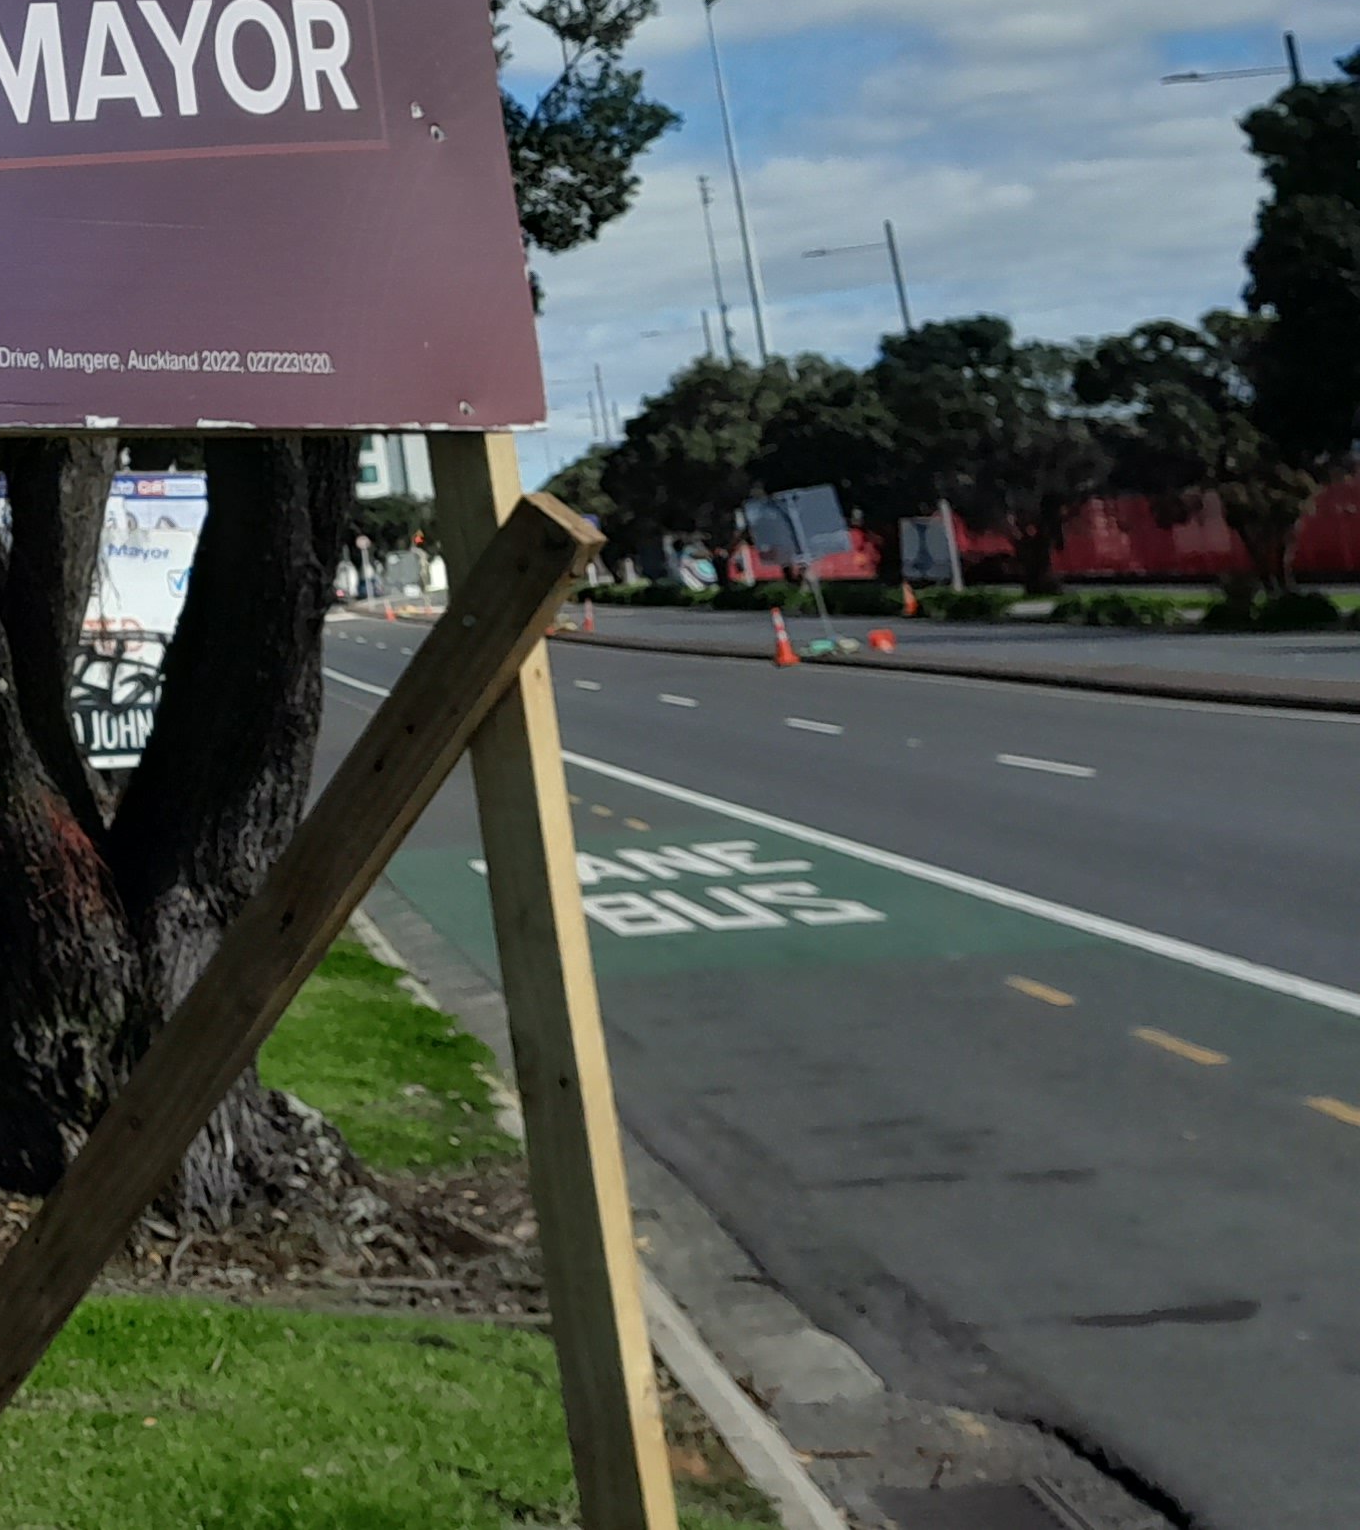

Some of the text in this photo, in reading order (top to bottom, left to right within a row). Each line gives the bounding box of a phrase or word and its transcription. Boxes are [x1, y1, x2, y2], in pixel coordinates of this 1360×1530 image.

[47, 348, 125, 374] Mangere,
[127, 349, 199, 371] Auckland
[201, 350, 245, 375] 2022,
[107, 543, 170, 563] Mayor
[467, 839, 813, 886] ANE
[583, 881, 887, 938] BUS
